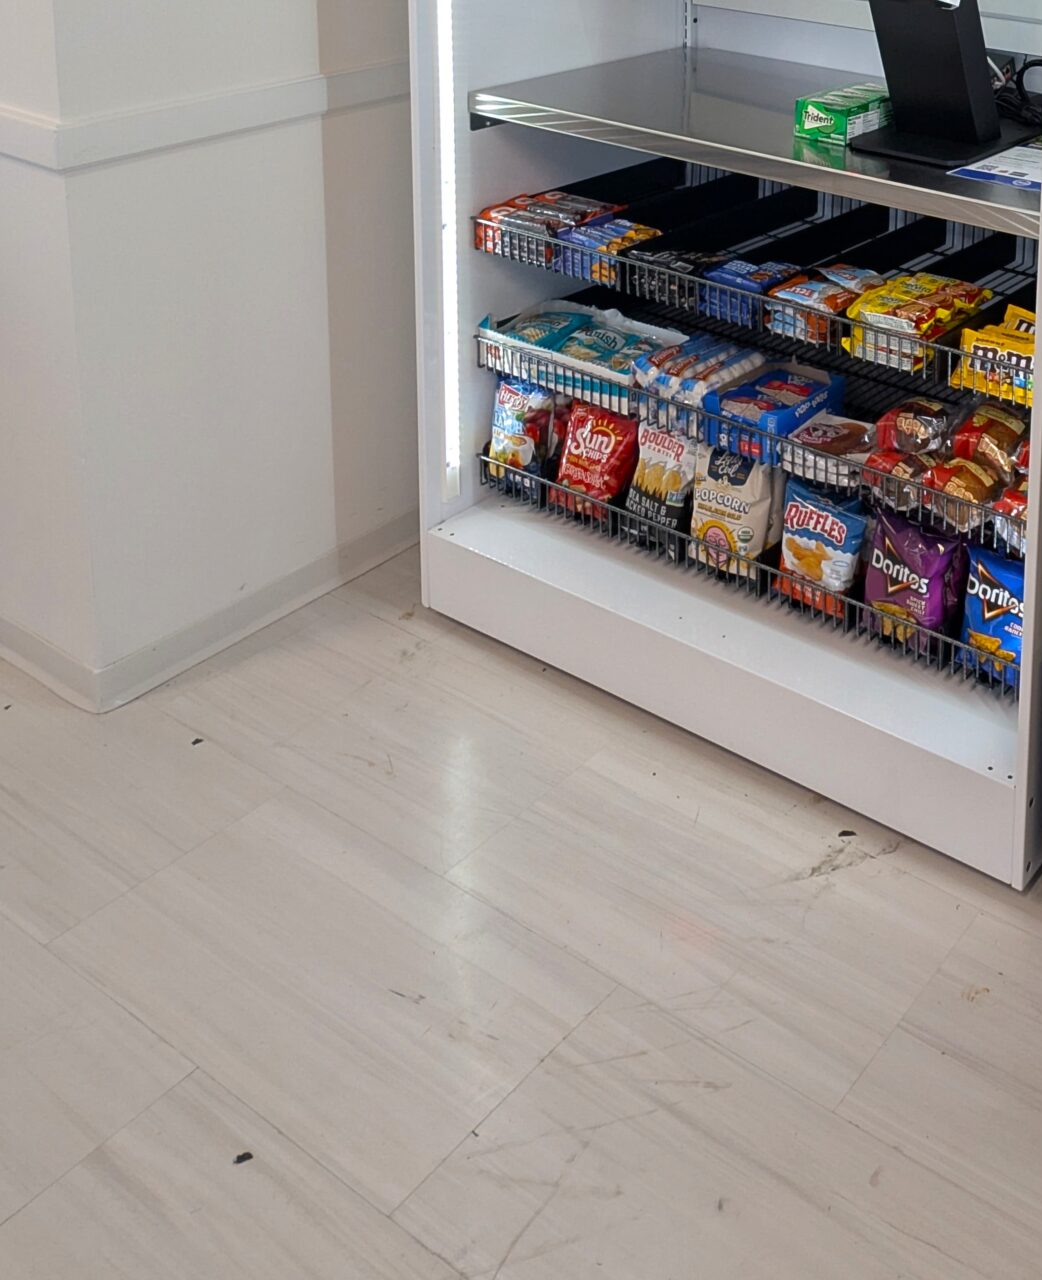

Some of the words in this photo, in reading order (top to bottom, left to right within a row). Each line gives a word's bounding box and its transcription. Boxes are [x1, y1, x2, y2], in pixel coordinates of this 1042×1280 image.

[803, 110, 834, 126] Trident
[570, 416, 615, 456] Sun
[639, 426, 686, 464] BOULDER
[584, 447, 610, 463] CHIPS
[640, 494, 660, 512] SALT
[694, 486, 751, 516] POPCORN
[783, 501, 847, 546] RUFFLES
[871, 547, 930, 595] Doritos
